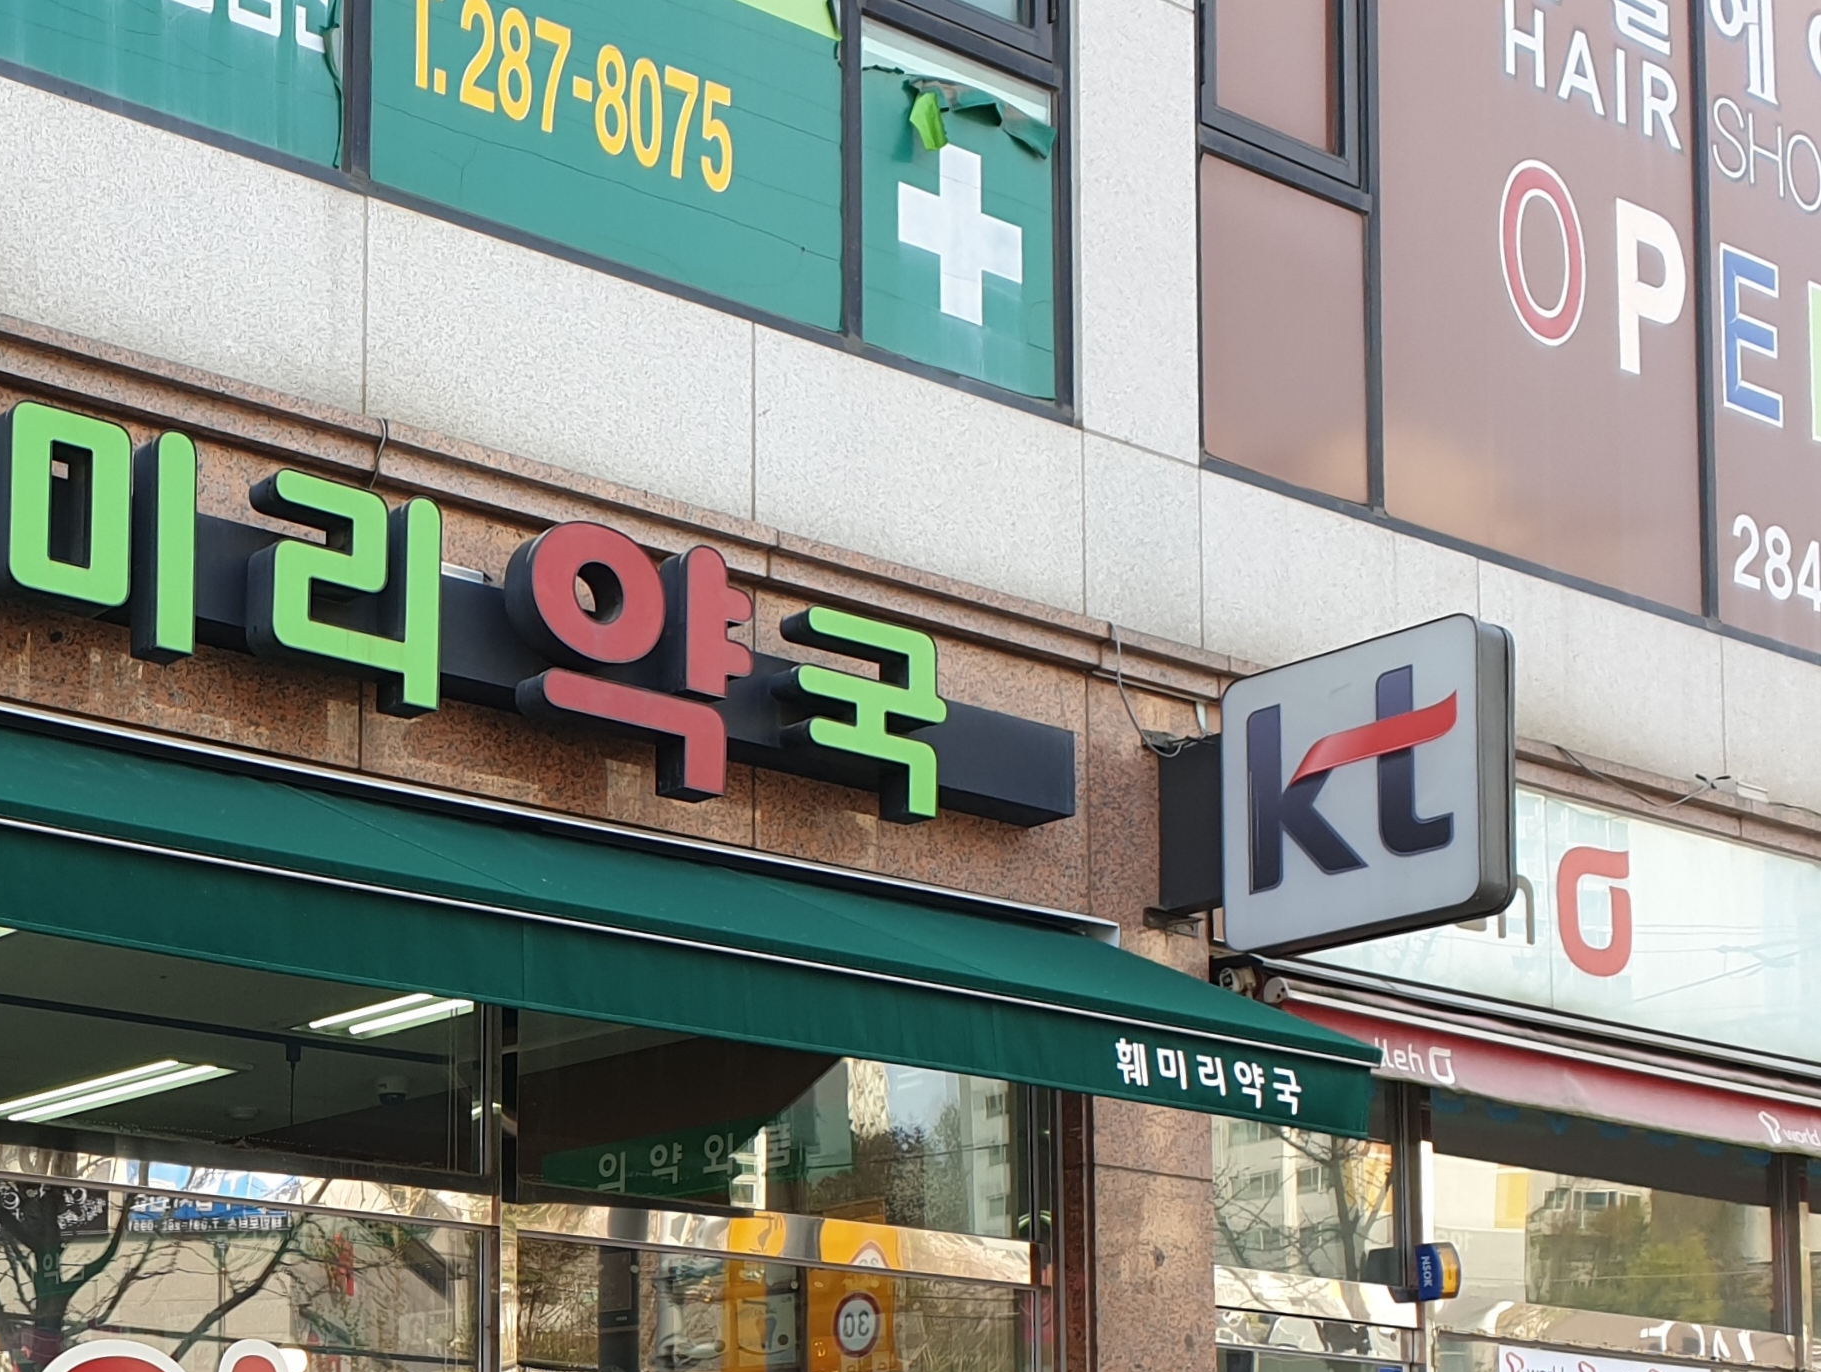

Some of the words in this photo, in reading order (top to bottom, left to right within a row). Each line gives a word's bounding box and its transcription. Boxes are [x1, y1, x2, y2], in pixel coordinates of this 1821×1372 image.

[1504, 7, 1682, 151] HAIR
[1499, 159, 1821, 443] OPE
[1246, 663, 1458, 897] kt
[1115, 1036, 1303, 1116] 훼미리약국
